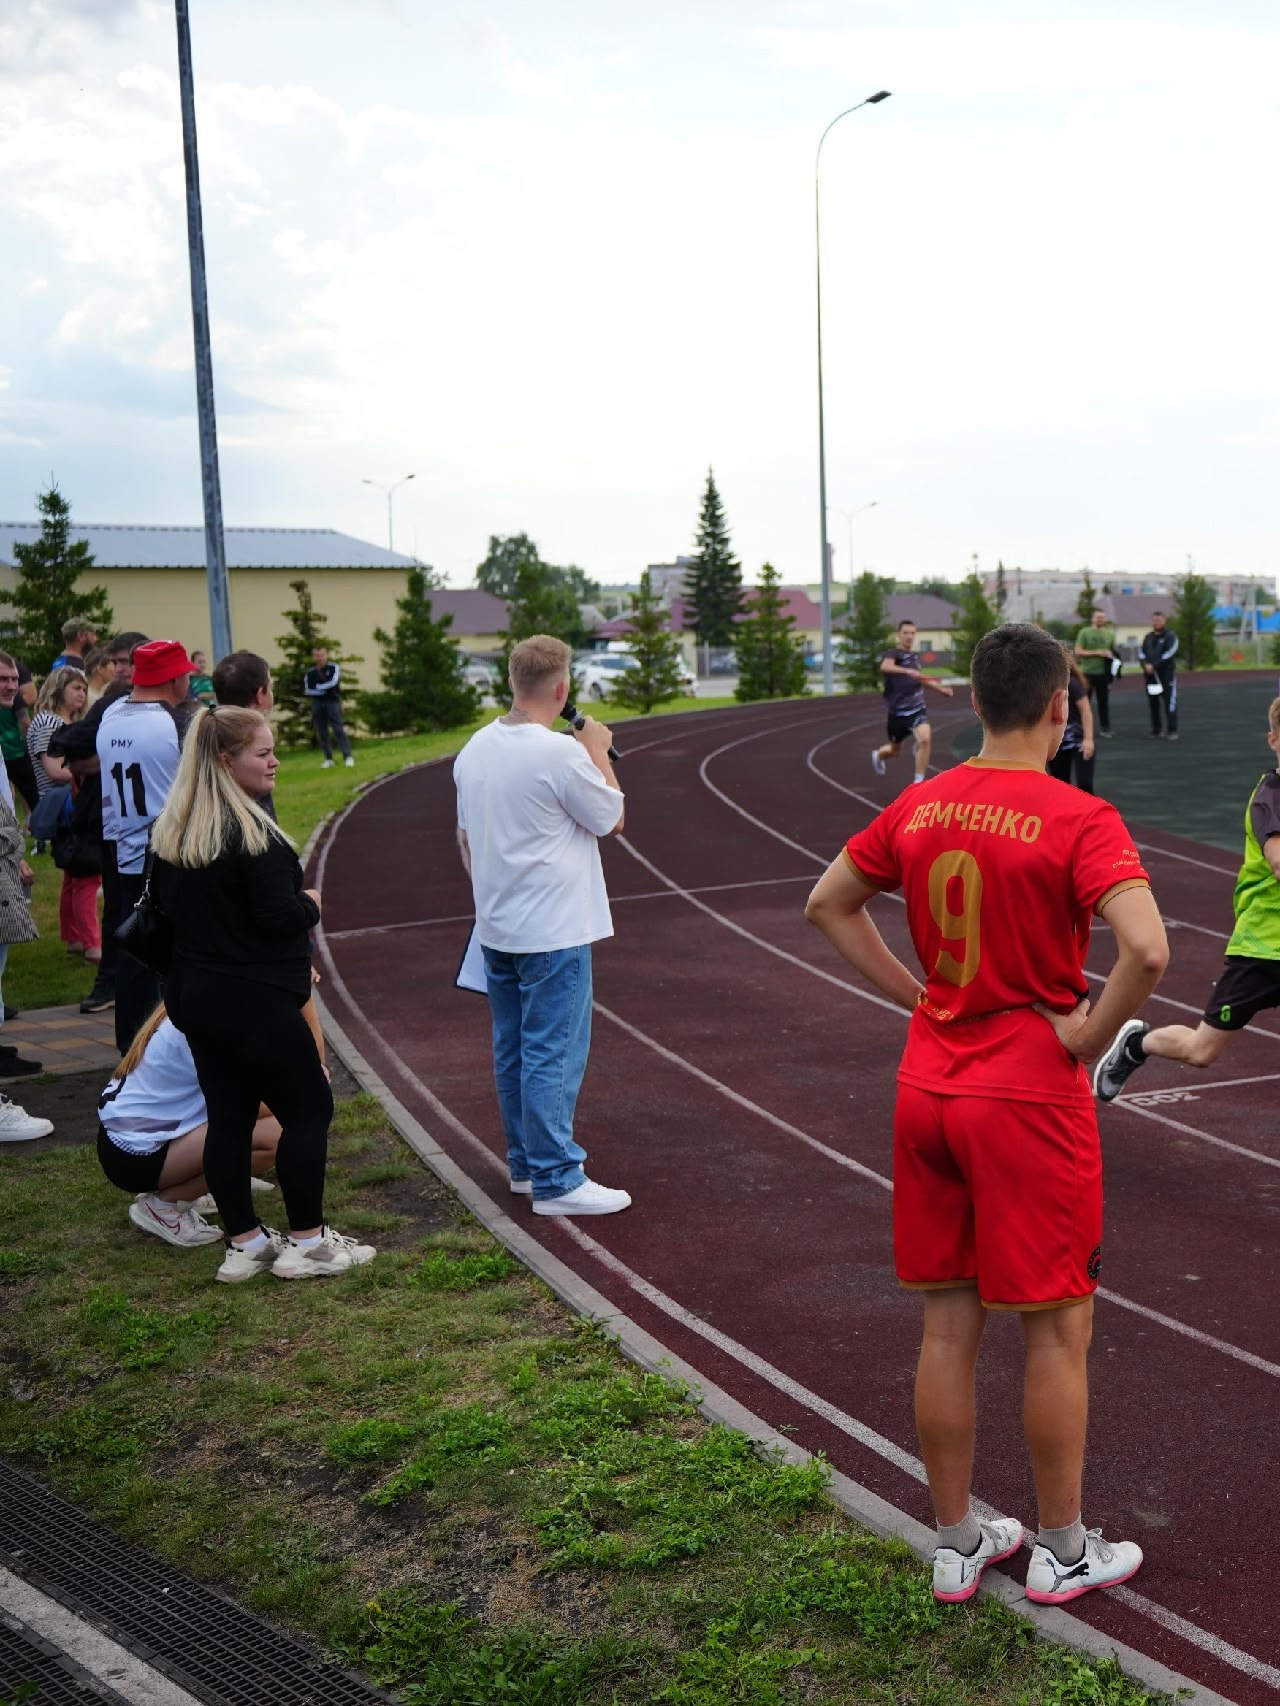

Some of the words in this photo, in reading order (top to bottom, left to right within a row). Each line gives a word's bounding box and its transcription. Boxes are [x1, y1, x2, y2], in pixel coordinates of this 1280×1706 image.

[111, 762, 148, 818] 11
[903, 801, 1043, 844] ДЕМЧЕНКО
[928, 850, 983, 989] 9
